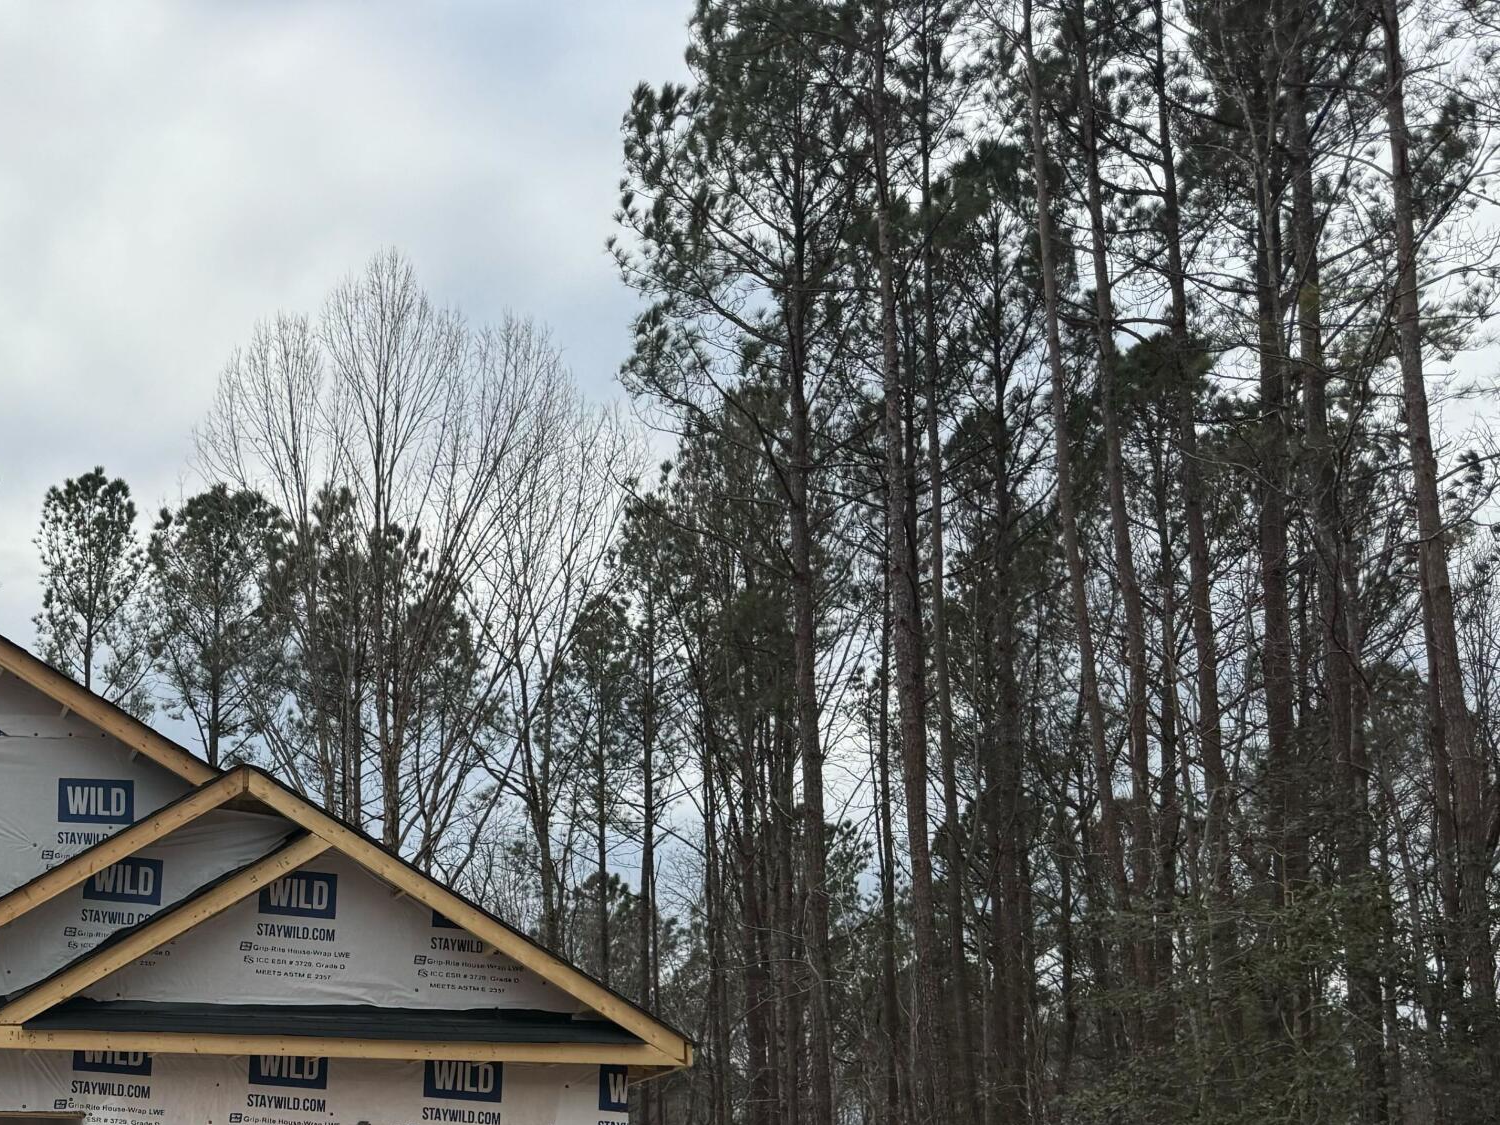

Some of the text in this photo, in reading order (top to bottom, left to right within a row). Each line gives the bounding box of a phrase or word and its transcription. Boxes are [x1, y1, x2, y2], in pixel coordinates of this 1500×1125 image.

[67, 785, 126, 817] WILD
[94, 864, 154, 896] WILD
[268, 877, 328, 910] WILD
[257, 924, 335, 942] STAYWILD.COM
[259, 1055, 319, 1080] WILD
[433, 1060, 494, 1093] WILD
[72, 1079, 150, 1098] STAYWILD.COM
[247, 1094, 326, 1113] STAYWILD.COM
[422, 1107, 500, 1124] STAYWILD.COM
